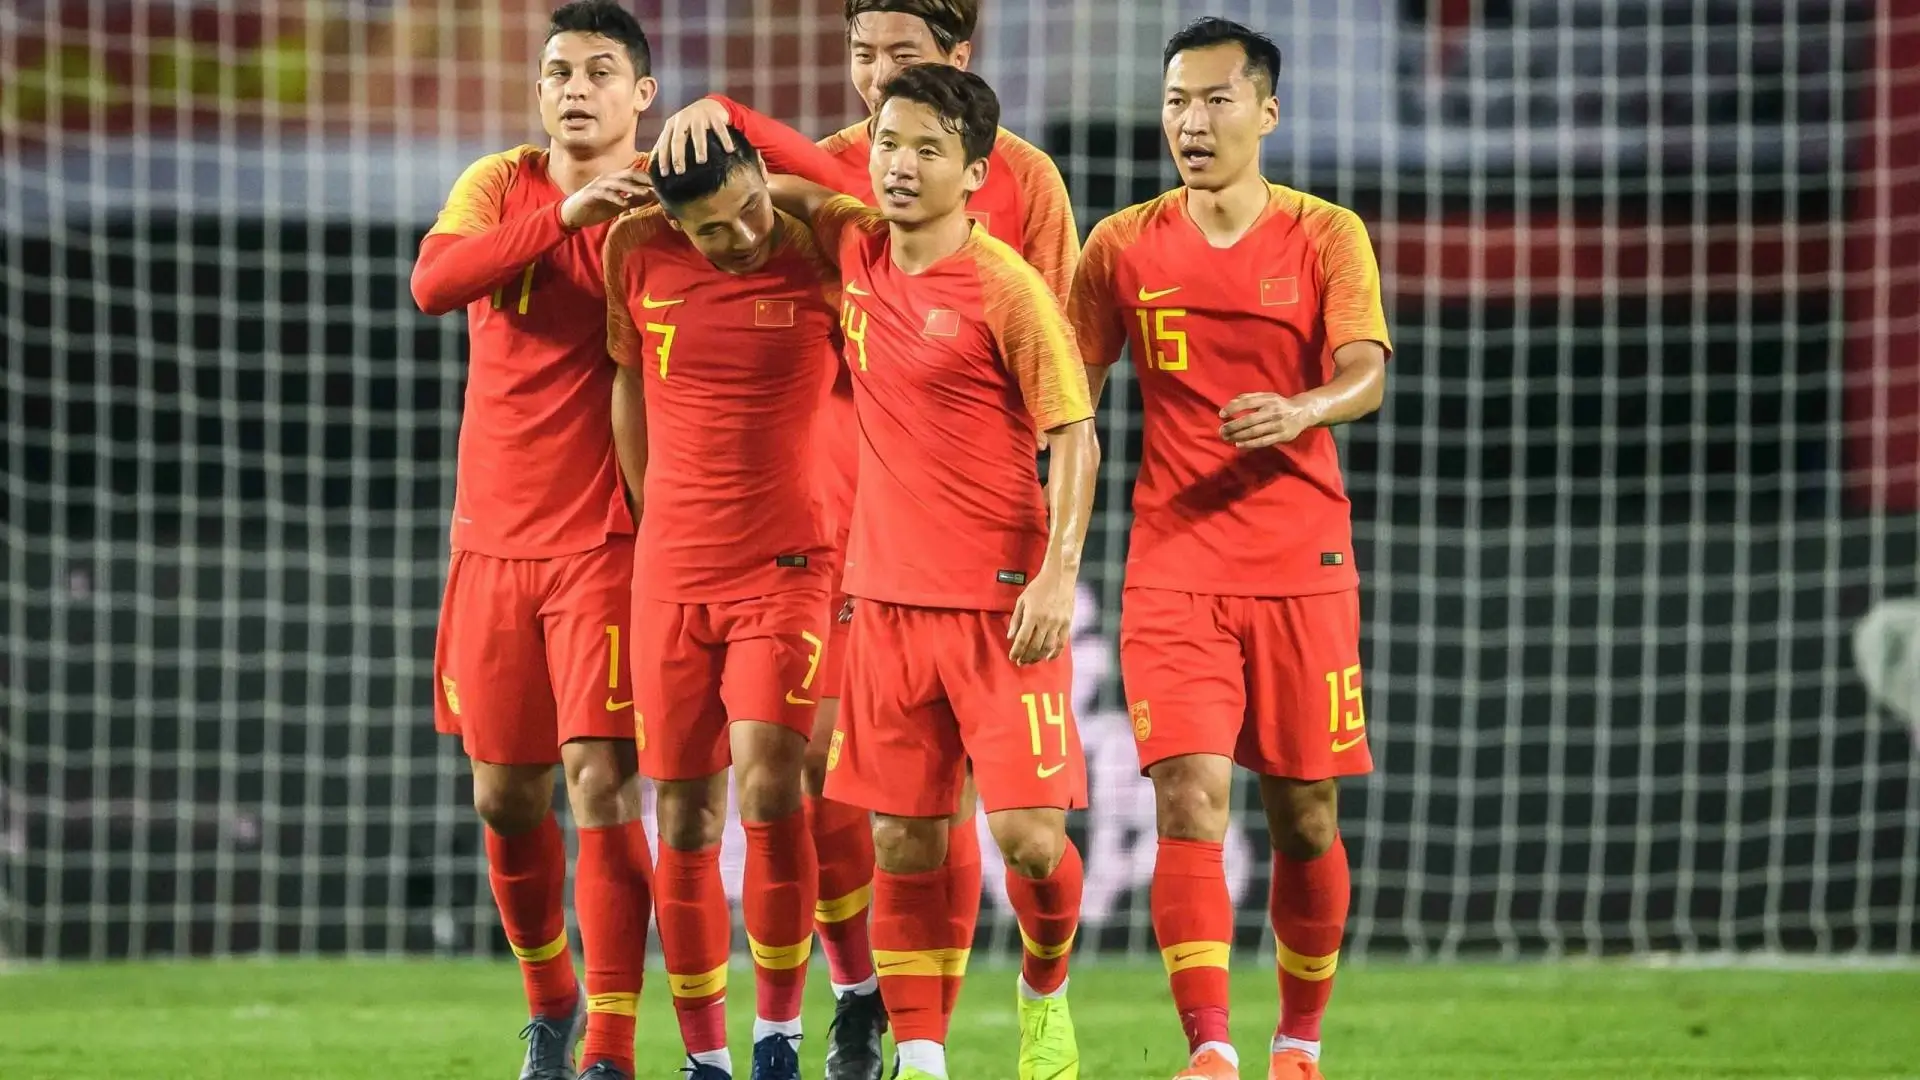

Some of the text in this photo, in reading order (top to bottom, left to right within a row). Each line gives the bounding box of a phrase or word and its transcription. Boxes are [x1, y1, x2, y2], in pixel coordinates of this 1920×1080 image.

[646, 322, 676, 380] 7
[1136, 308, 1187, 371] 15
[801, 630, 822, 690] 7
[1021, 693, 1066, 756] 14
[1325, 663, 1365, 733] 15
